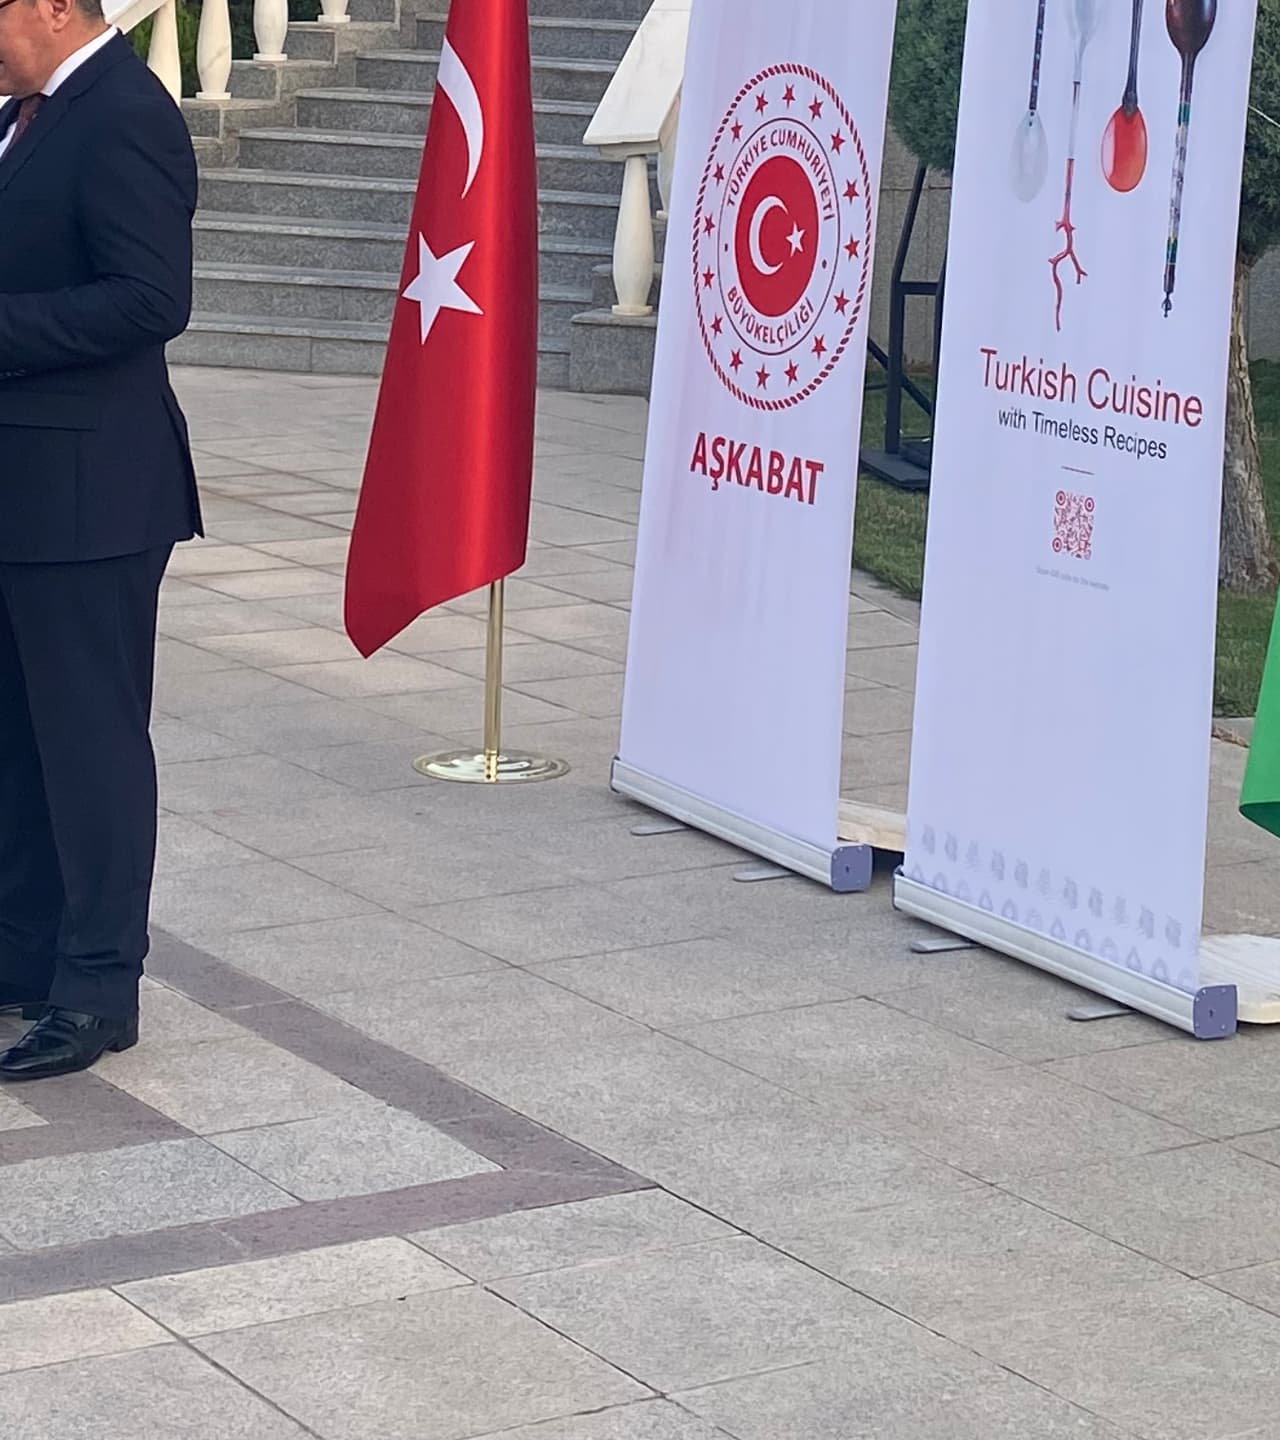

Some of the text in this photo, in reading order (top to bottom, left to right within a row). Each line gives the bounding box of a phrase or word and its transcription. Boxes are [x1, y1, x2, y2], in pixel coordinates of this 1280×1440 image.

[980, 348, 1203, 427] Turkish Cuisine
[690, 432, 824, 505] AŞKABAT
[998, 407, 1167, 460] with Timeless Recipes
